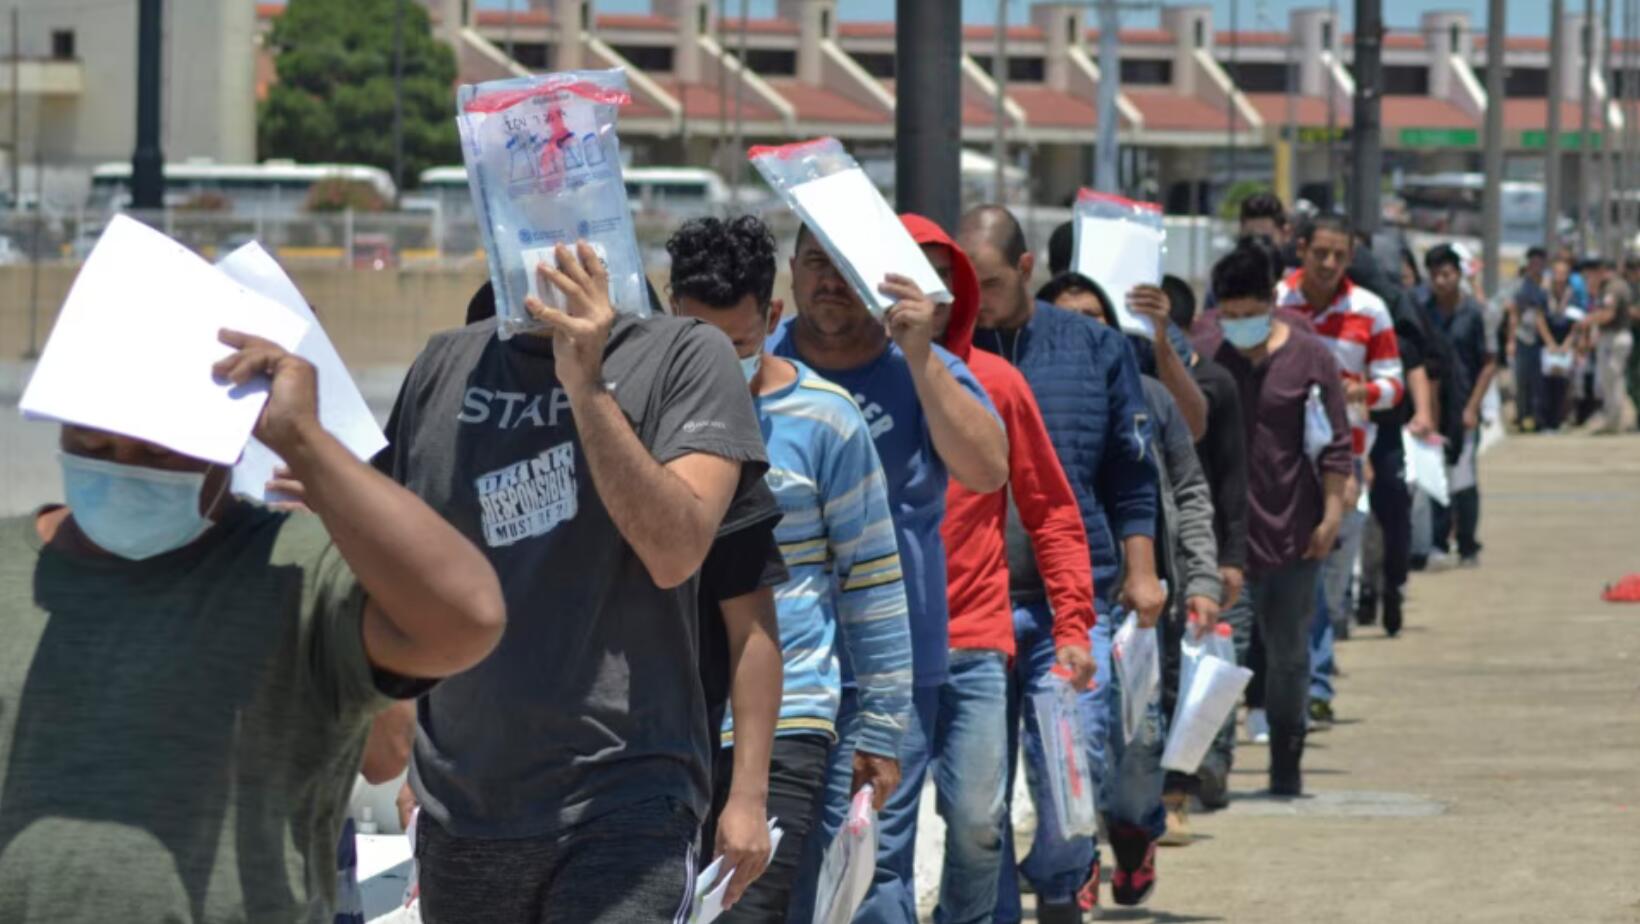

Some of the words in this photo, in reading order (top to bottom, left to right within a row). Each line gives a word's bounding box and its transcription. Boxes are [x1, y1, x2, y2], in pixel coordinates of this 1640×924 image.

[457, 386, 616, 432] STAF
[476, 441, 574, 490] DRINK
[496, 516, 533, 539] MUST
